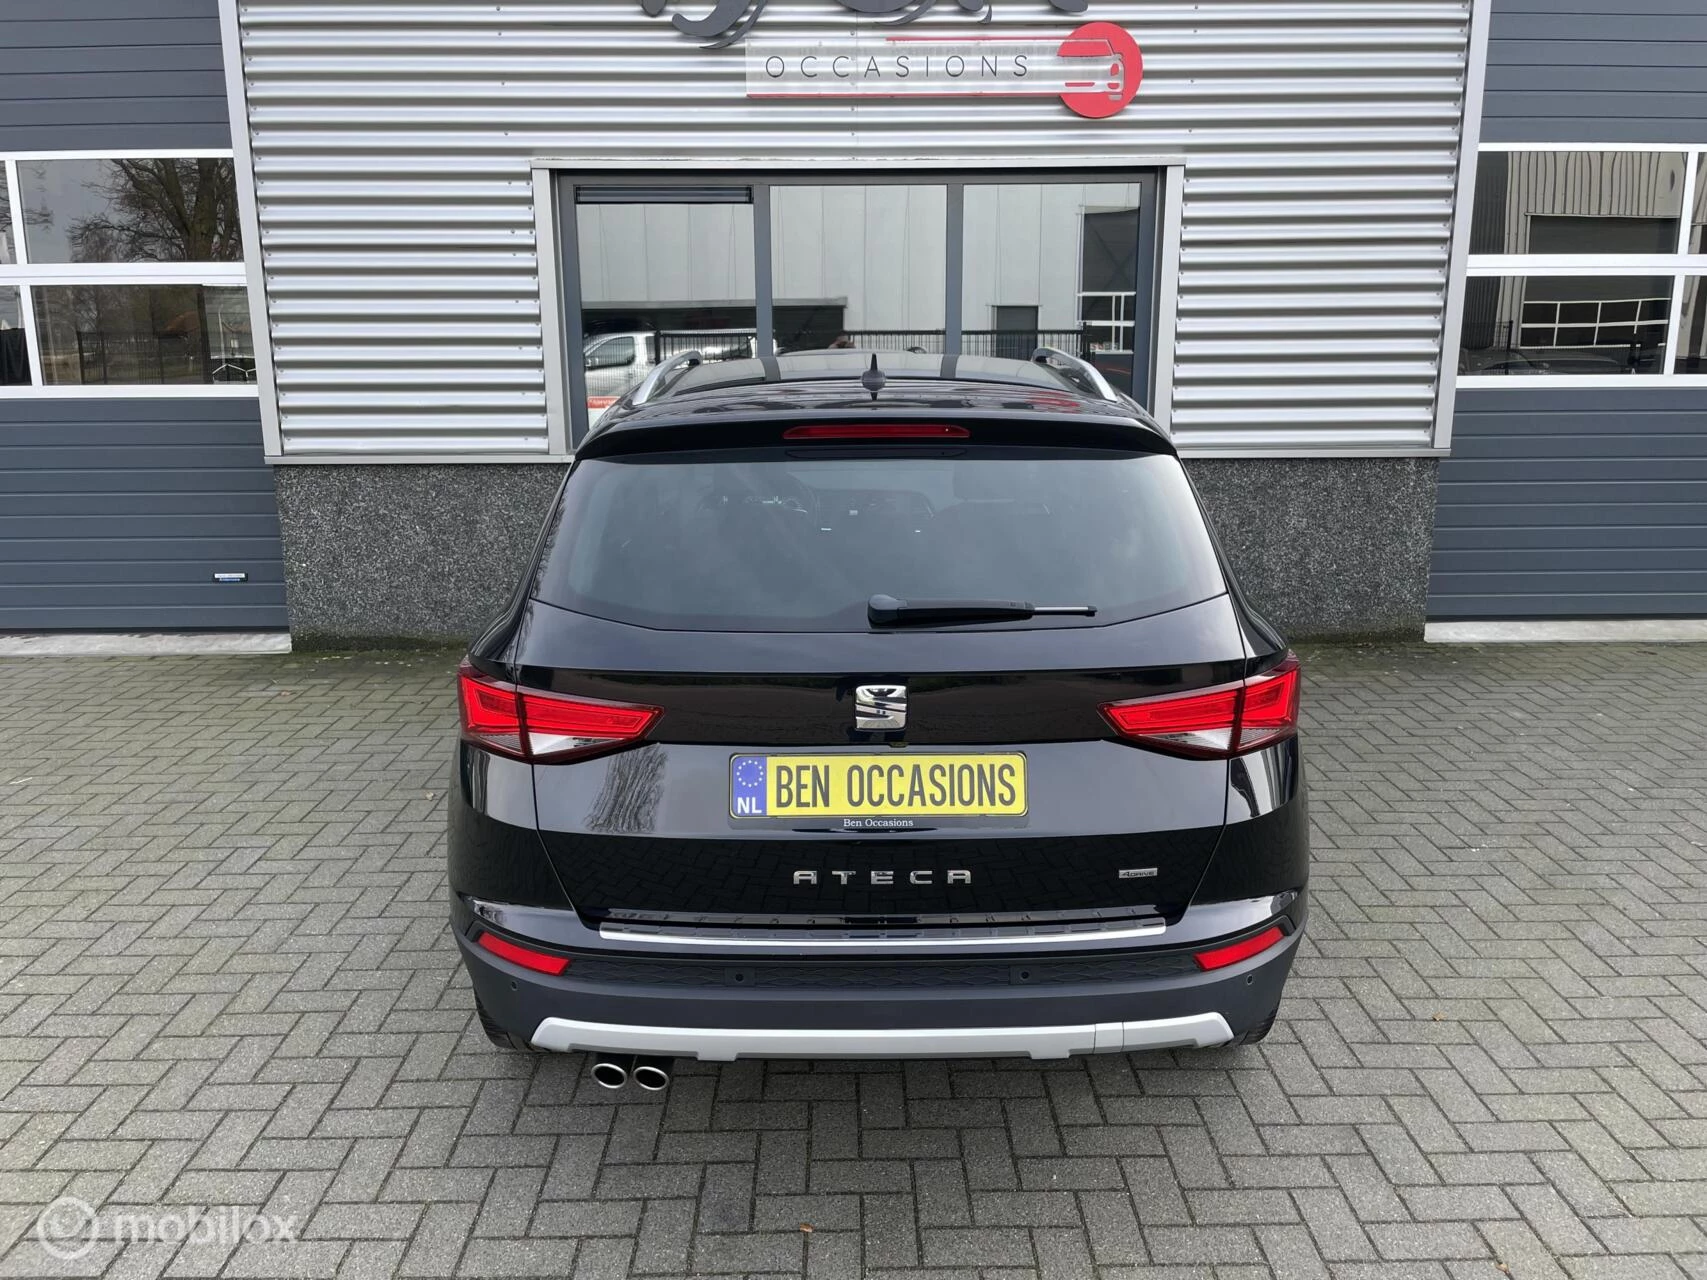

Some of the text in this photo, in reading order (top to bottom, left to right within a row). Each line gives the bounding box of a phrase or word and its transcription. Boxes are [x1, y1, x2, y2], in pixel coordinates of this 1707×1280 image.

[765, 55, 1029, 79] OCCASIONS
[775, 763, 1017, 808] BEN OCCASIONS
[736, 797, 762, 814] NL
[843, 818, 914, 828] Ben Occasions
[792, 869, 972, 885] ATECA
